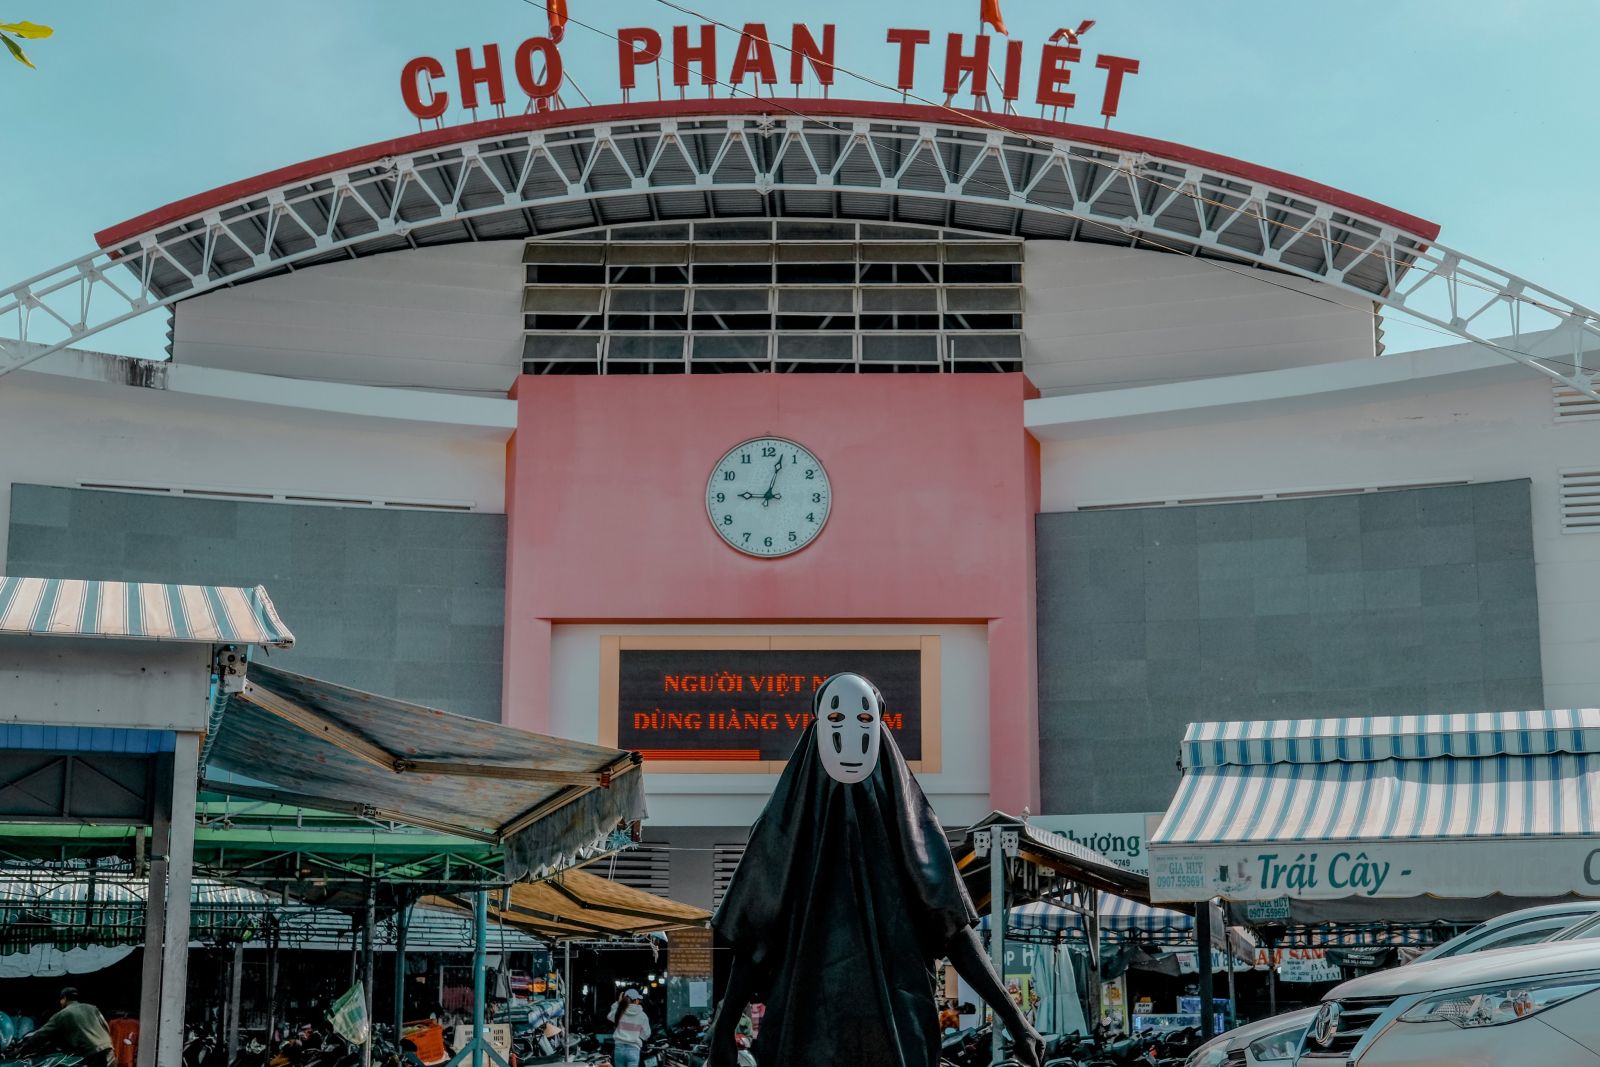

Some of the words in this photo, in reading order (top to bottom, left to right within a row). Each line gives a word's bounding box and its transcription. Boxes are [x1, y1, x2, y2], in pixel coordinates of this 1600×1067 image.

[400, 25, 564, 119] CHỢ
[617, 23, 836, 89] PHAN
[887, 20, 1139, 117] THIẾT
[762, 447, 776, 457] 12
[741, 454, 751, 464] 11
[792, 455, 797, 464] 1
[724, 471, 735, 481] 10
[805, 469, 814, 480] 2
[716, 492, 725, 503] 9
[812, 493, 820, 503] 3
[724, 514, 733, 525] 8
[806, 512, 814, 522] 4
[742, 532, 751, 542] 7
[788, 531, 797, 541] 5
[764, 537, 772, 547] 6
[664, 671, 743, 692] NGƯỜI
[750, 673, 805, 697] VIỆT
[633, 708, 702, 730] DÙNG
[708, 708, 778, 730] HÀNG
[1186, 862, 1203, 874] HUY
[1257, 853, 1318, 889] Trái
[1328, 852, 1390, 896] Cây
